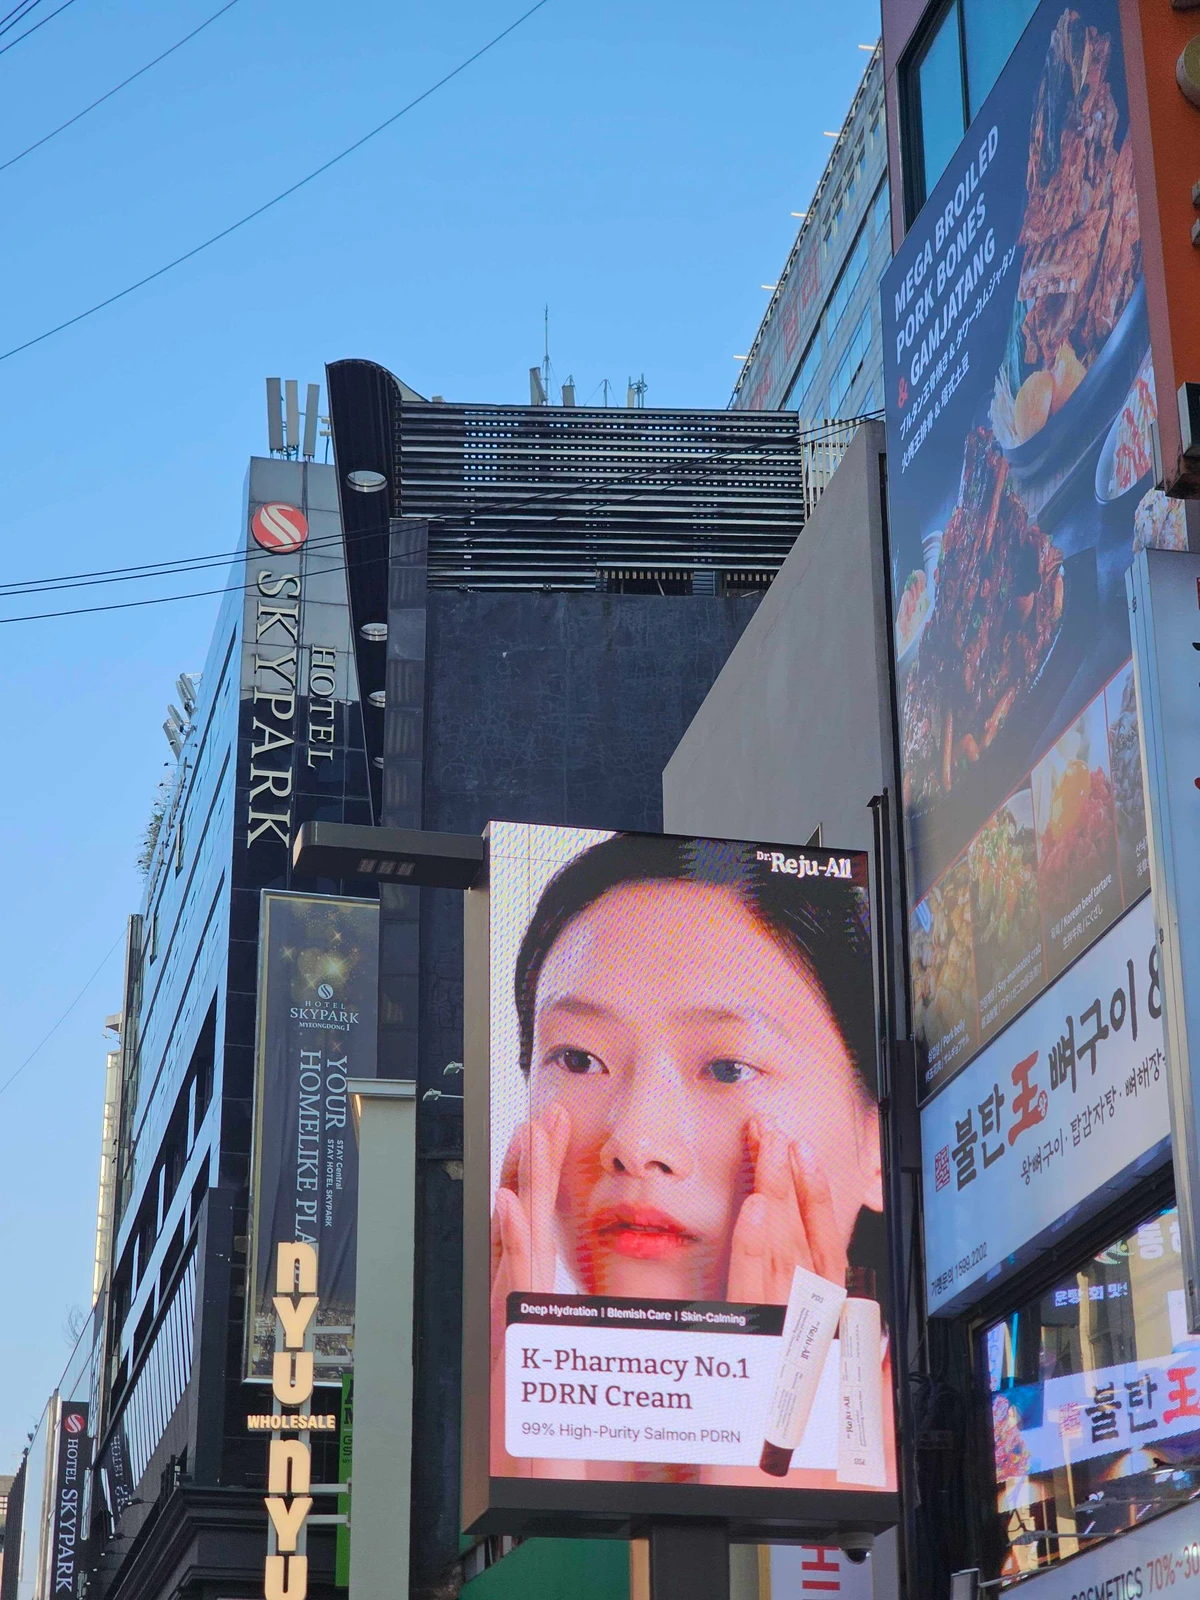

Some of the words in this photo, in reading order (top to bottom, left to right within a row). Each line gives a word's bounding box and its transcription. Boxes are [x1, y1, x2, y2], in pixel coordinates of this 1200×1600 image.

[894, 238, 933, 323] MEGA
[935, 124, 998, 254] BROILED
[896, 277, 934, 365] PORK
[936, 192, 986, 297] BONES
[898, 377, 908, 409] &
[910, 227, 995, 386] GAMJATANG
[247, 570, 301, 849] SKYPARK
[307, 642, 337, 769] HOTEL
[1081, 888, 1093, 909] beef
[1093, 873, 1112, 898] tartare
[290, 1007, 360, 1024] SKYPARK
[304, 1000, 346, 1010] HOTEL
[299, 1022, 346, 1031] MYEONGDONG
[943, 1028, 954, 1047] Pork
[1125, 1048, 1166, 1098] 뼈해장
[325, 1055, 348, 1131] YOUR
[296, 1049, 322, 1192] HOMELIKE
[326, 1138, 334, 1161] STAY
[326, 1161, 334, 1188] HOTEL
[335, 1162, 343, 1190] Central
[324, 1189, 333, 1227] SKYPARK
[931, 1266, 954, 1297] 가맹문의
[520, 1303, 548, 1317] Deep
[549, 1304, 598, 1318] Hydration
[607, 1307, 647, 1320] Blemish
[647, 1309, 672, 1321] Care
[680, 1310, 747, 1327] Skin-Calming
[521, 1347, 689, 1382] K-Pharmacy
[694, 1355, 750, 1379] No.1
[521, 1381, 599, 1405] PDRN
[605, 1385, 693, 1410] Cream
[247, 1414, 336, 1431] WHOLESALE
[521, 1422, 555, 1436] 99%
[559, 1423, 640, 1443] High-Purity
[644, 1427, 697, 1442] Salmon
[700, 1429, 741, 1443] PDRN
[65, 1438, 79, 1485] HOTEL
[55, 1488, 79, 1593] SKYPARK
